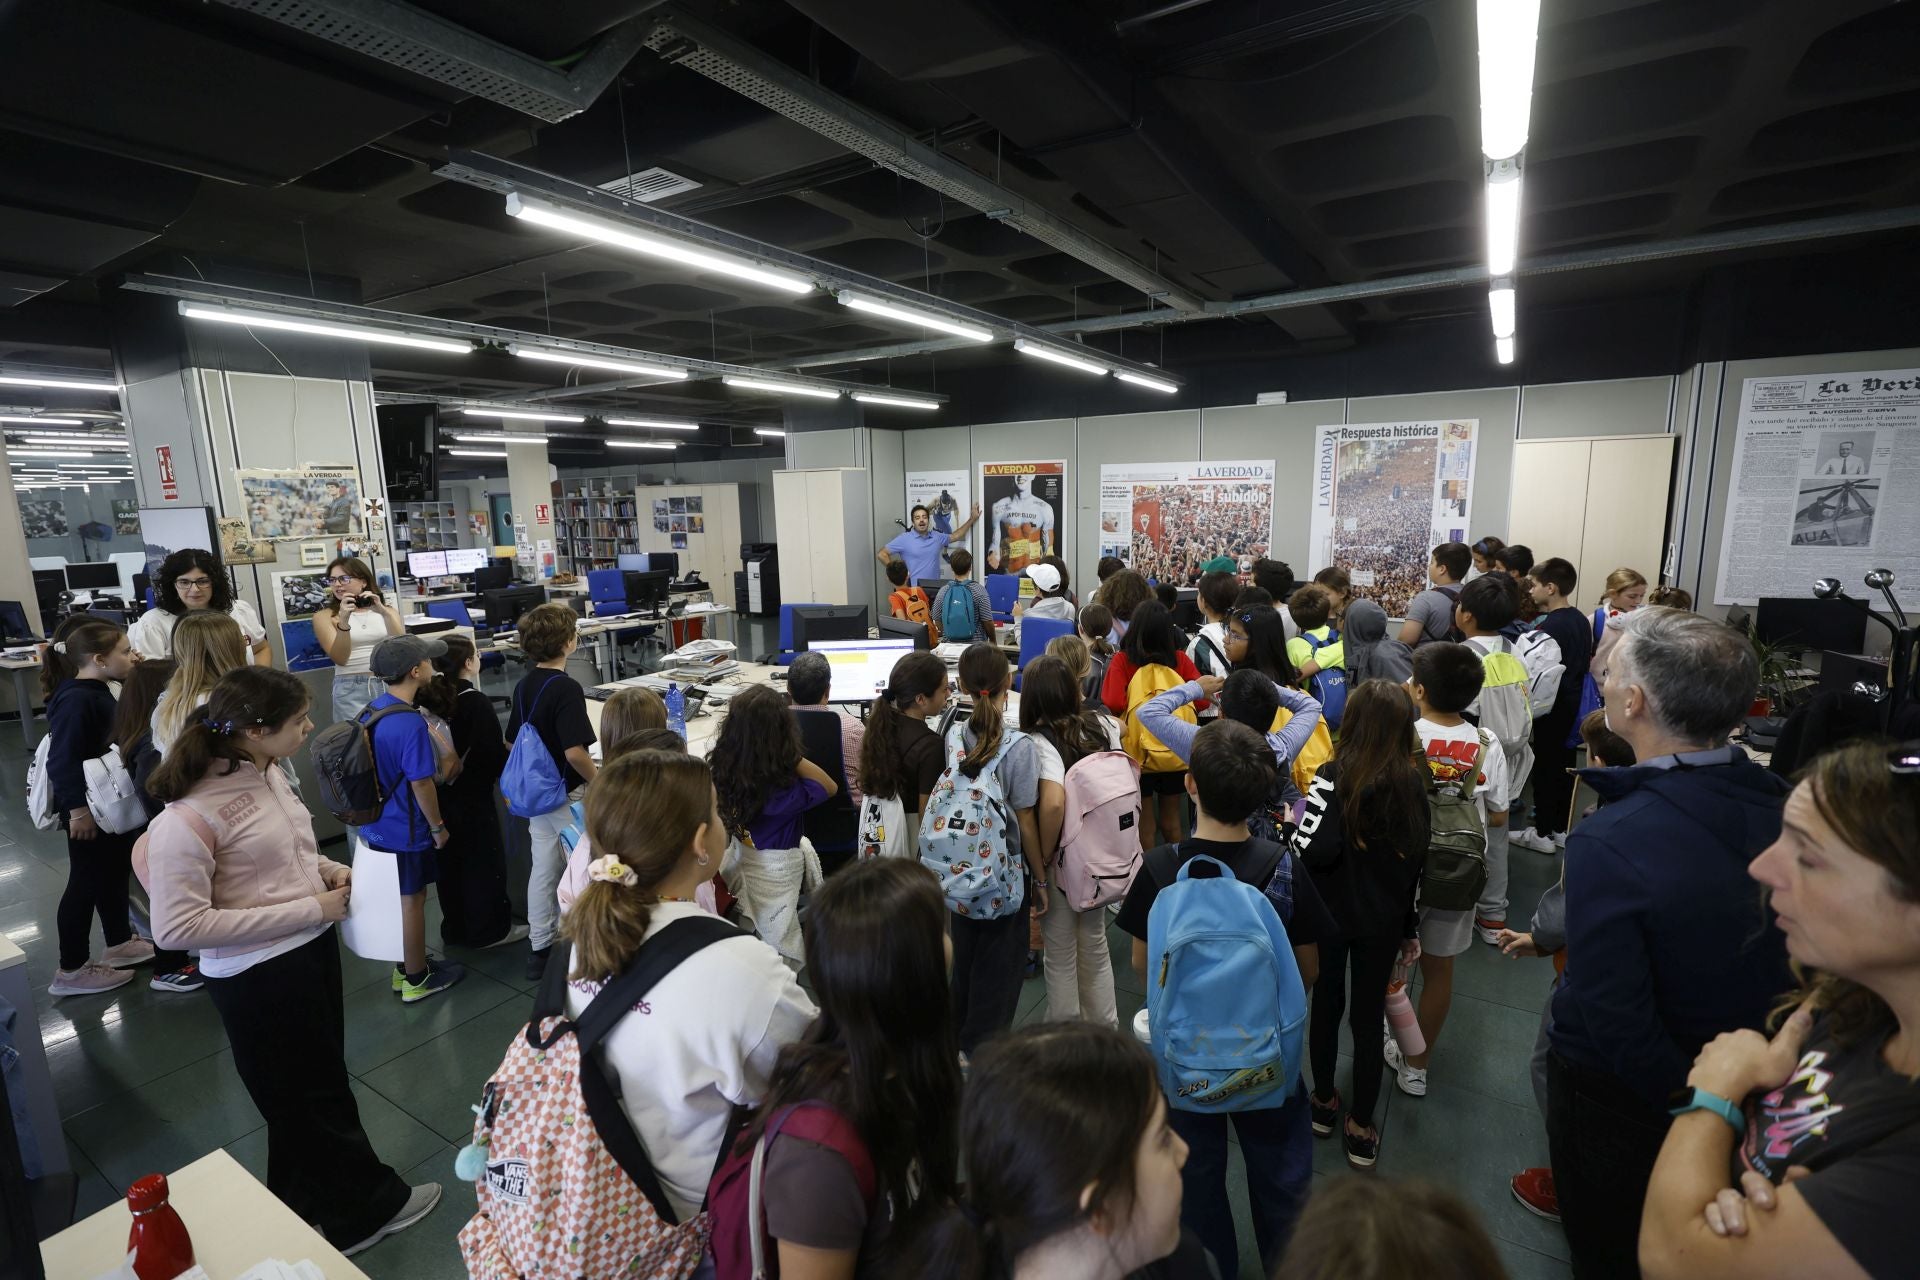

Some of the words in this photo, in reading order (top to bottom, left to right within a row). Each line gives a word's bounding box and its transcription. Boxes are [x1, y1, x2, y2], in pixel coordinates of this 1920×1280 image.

[1818, 380, 1852, 398] La
[1341, 427, 1391, 440] Respuesta
[1393, 424, 1439, 438] histórica
[984, 467, 998, 475] LA
[998, 464, 1036, 475] VERDAD
[1197, 468, 1212, 477] LA
[1213, 466, 1264, 477] VERDAD
[1320, 437, 1334, 491] VERDAD
[1203, 489, 1214, 503] El
[1217, 489, 1267, 503] subidón
[1319, 491, 1330, 507] LA
[223, 796, 250, 817] 2002
[504, 1162, 528, 1179] VANS
[504, 1176, 522, 1197] THE
